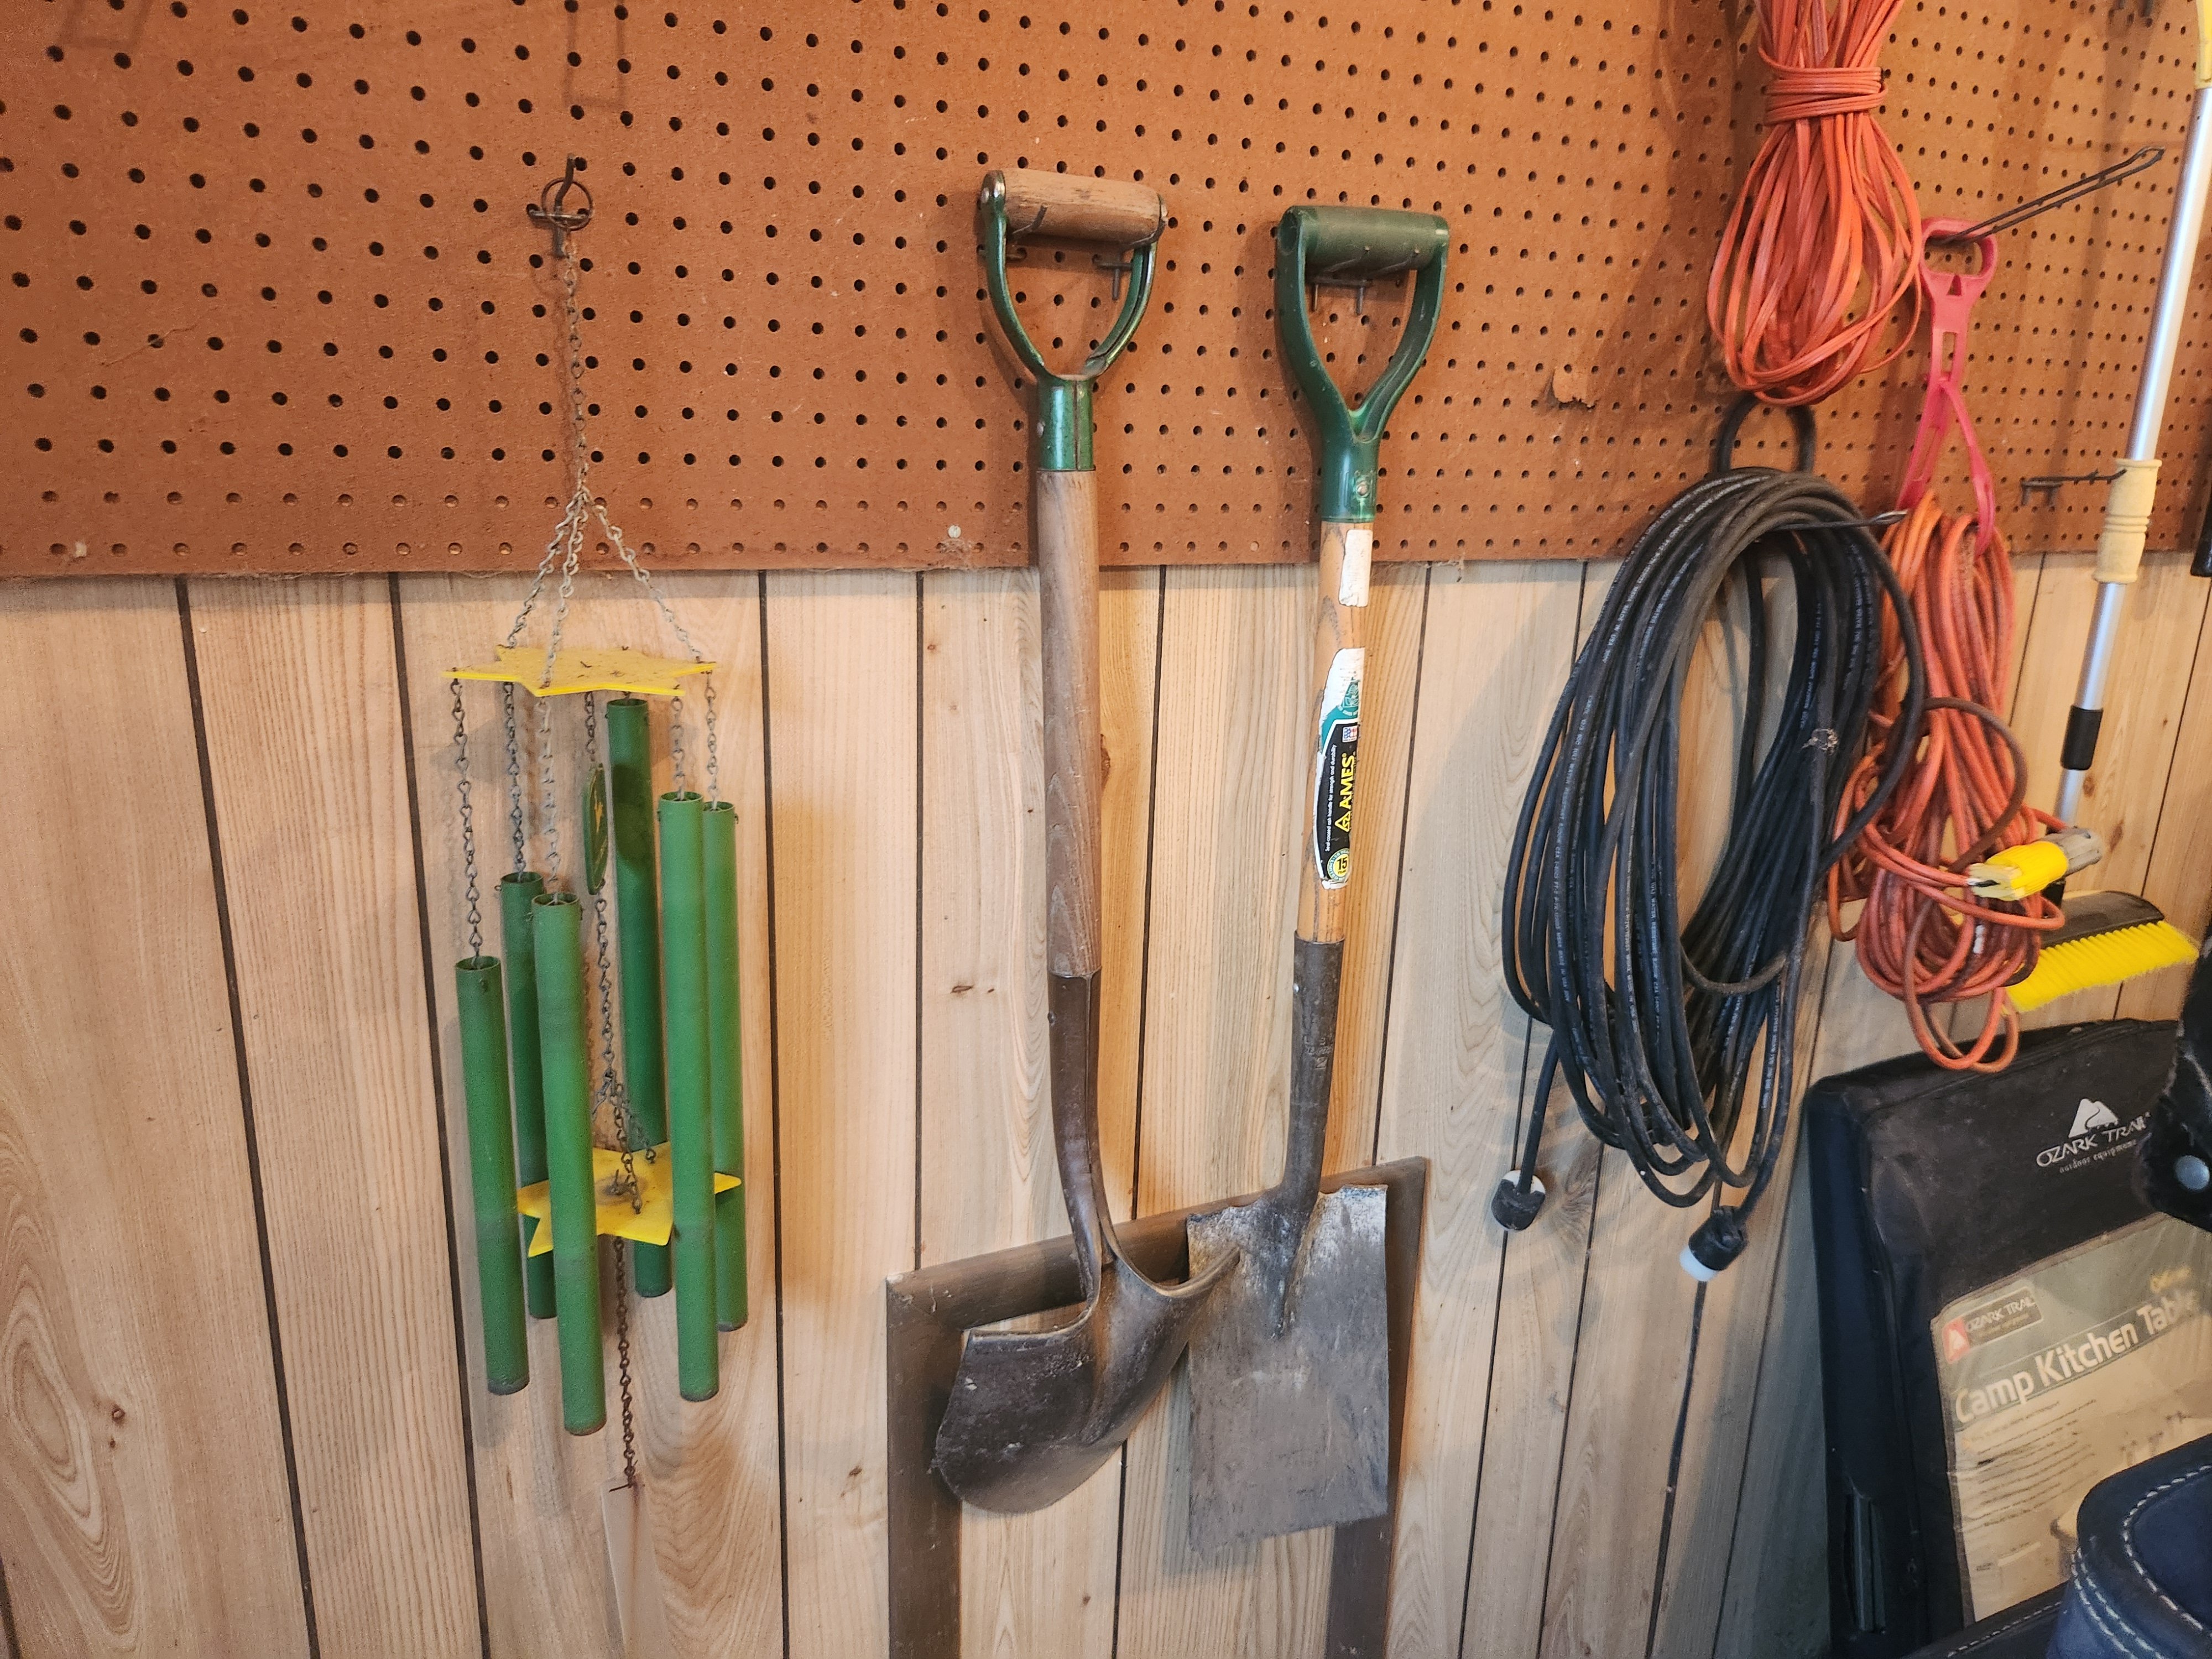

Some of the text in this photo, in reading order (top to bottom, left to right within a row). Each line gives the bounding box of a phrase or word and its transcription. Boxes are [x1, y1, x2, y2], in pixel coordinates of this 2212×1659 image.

[1606, 633, 1617, 647] USA
[1339, 755, 1355, 810] AMES
[1337, 856, 1348, 870] 15
[2036, 1134, 2099, 1167] OZARK
[1966, 1308, 2005, 1333] OZARK
[1955, 1370, 2034, 1423] Camp
[2034, 1322, 2139, 1386] Kitchen
[2136, 1289, 2198, 1335] Tab
